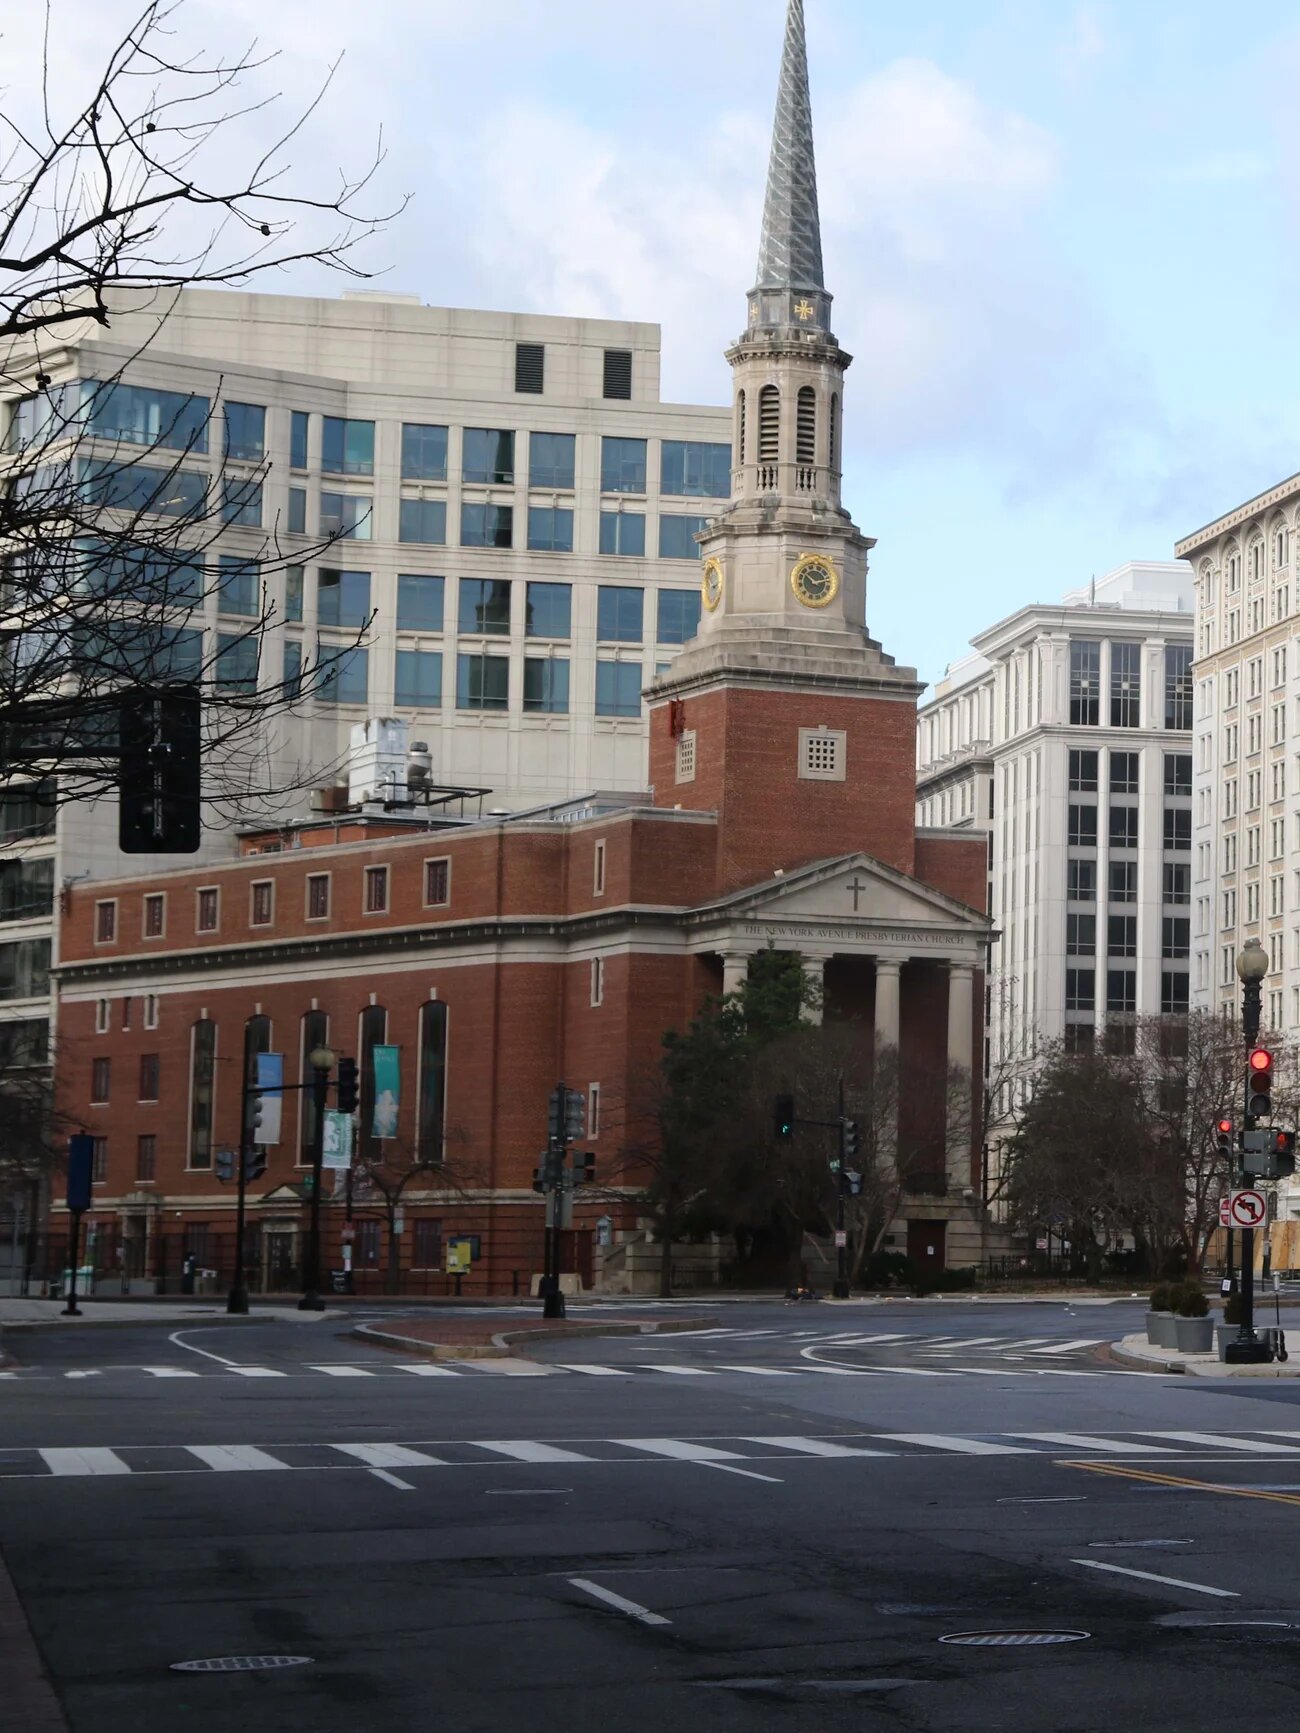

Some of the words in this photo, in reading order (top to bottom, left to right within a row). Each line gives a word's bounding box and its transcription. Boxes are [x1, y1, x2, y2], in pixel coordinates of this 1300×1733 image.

[744, 925, 762, 934] THE
[765, 927, 786, 936] NEW
[788, 927, 814, 937] YORK
[818, 929, 852, 940] AVENUE
[855, 931, 923, 942] PRESBYTERIAN
[925, 935, 964, 945] CHURCH
